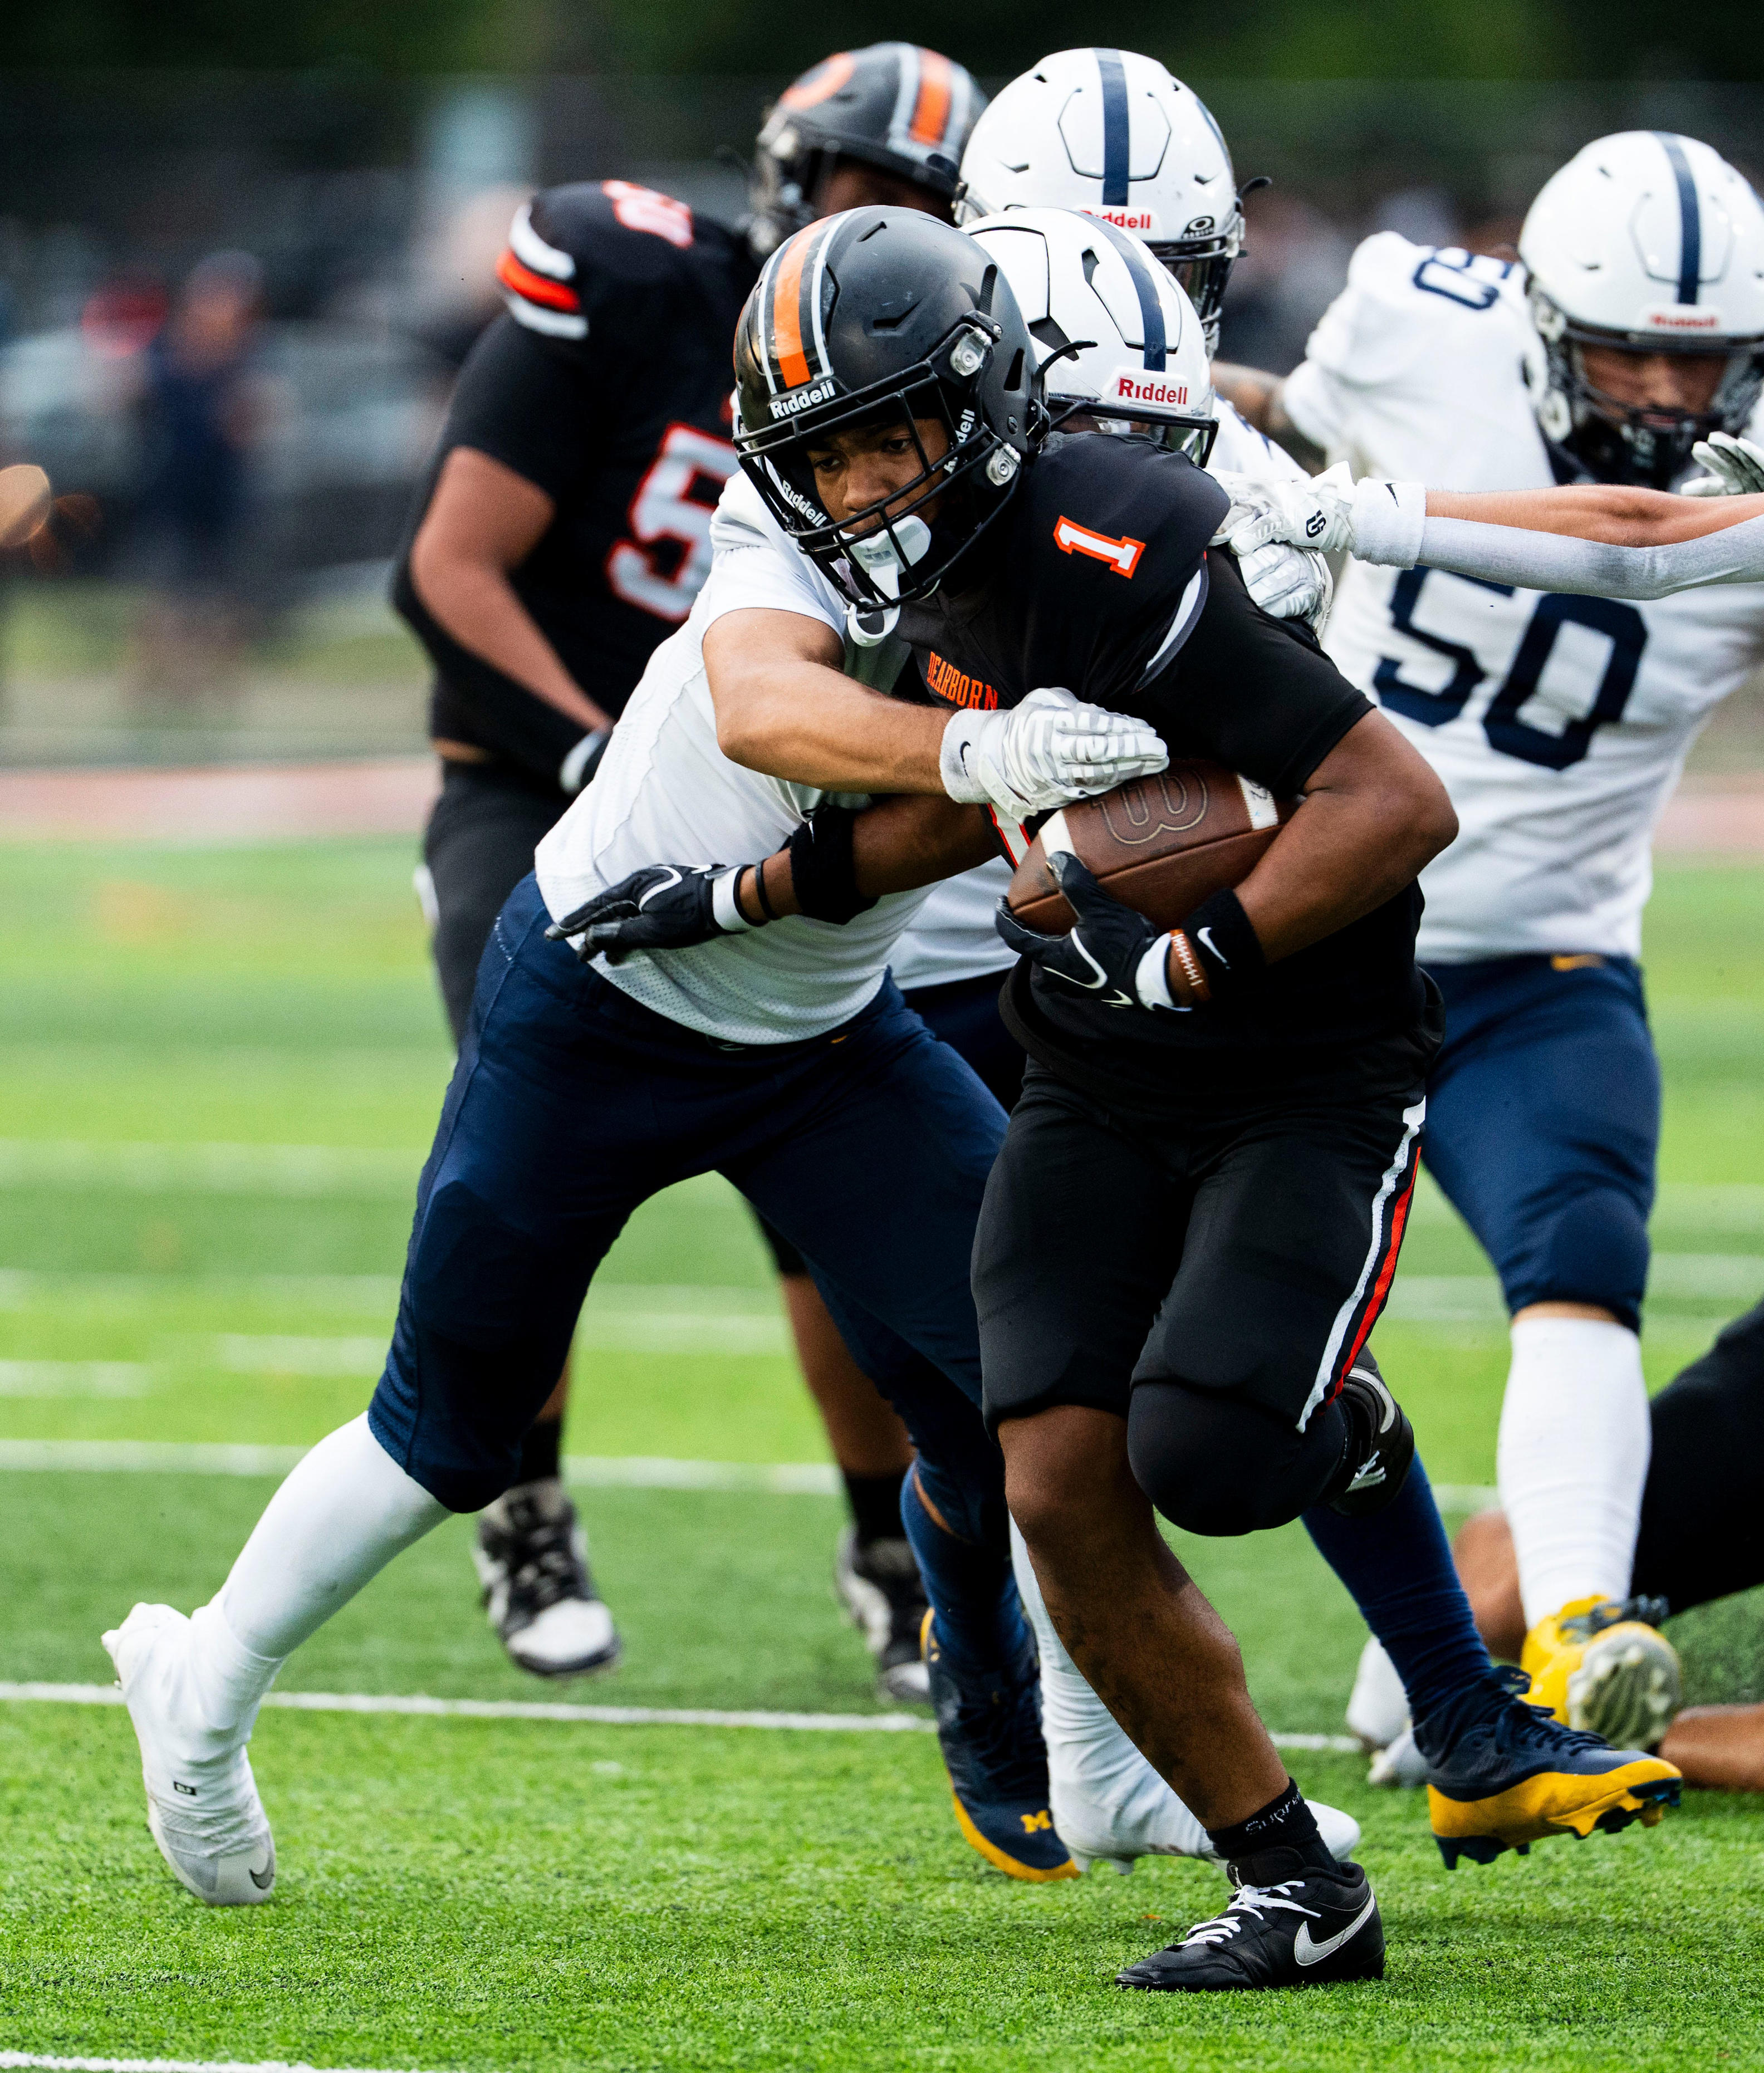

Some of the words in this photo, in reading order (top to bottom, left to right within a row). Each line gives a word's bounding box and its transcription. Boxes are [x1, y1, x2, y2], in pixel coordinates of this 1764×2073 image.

[770, 379, 836, 419] Riddell
[1118, 378, 1188, 405] Riddell
[782, 479, 827, 527] Riddell
[1053, 515, 1146, 579] 1
[927, 651, 998, 710] DEARBORN
[1373, 563, 1648, 771] 50
